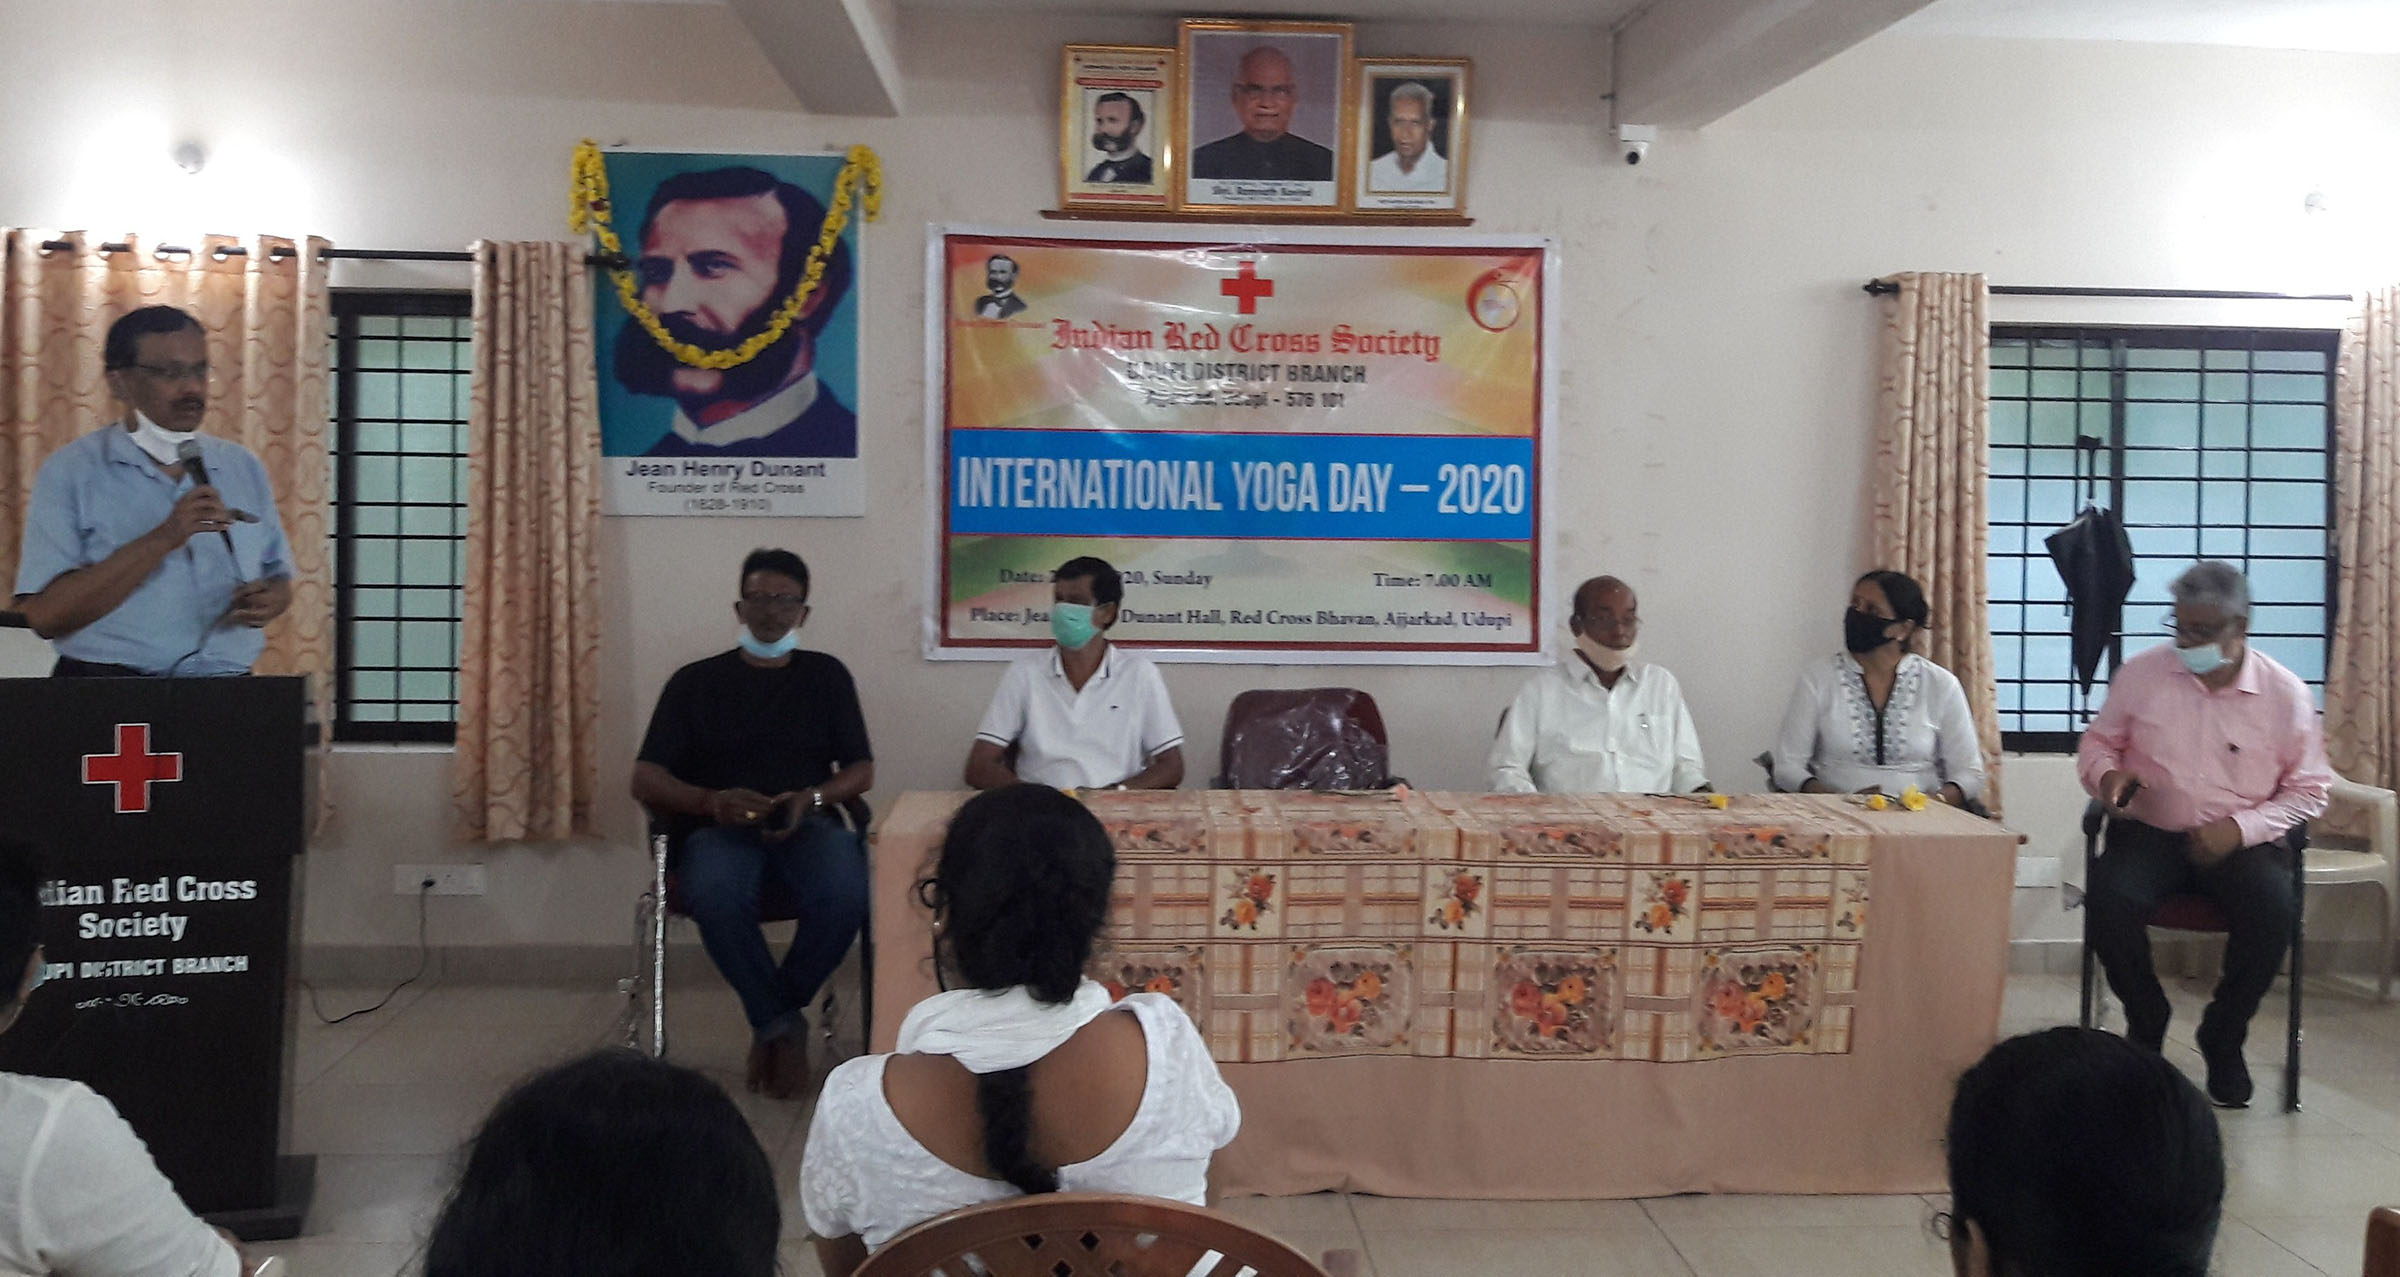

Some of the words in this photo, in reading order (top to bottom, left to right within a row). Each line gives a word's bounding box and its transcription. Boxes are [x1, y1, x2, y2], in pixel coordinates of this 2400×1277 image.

[1051, 319, 1153, 350] Indian
[1164, 322, 1221, 351] Red
[1229, 324, 1320, 354] Cross
[1331, 325, 1442, 362] Society
[1194, 362, 1280, 382] DISTRICT
[1286, 364, 1366, 384] BRANCH
[625, 461, 677, 477] Jean
[682, 461, 745, 481] Henry
[751, 461, 826, 478] Dunant
[648, 481, 706, 494] Founder
[712, 482, 727, 494] of
[730, 482, 760, 494] Red
[764, 482, 805, 495] Cross
[958, 457, 1223, 512] INTERNATIONAL
[1231, 461, 1319, 513] YOGA
[1328, 463, 1393, 513] DAY
[1437, 464, 1526, 515] 2020
[1000, 568, 1044, 584] Date:
[1152, 570, 1213, 589] Sunday
[1373, 572, 1421, 587] Time:
[1424, 573, 1460, 588] 7.00
[1463, 573, 1493, 588] AM
[970, 607, 1019, 623] Place:
[1021, 607, 1051, 626] Jea
[1121, 609, 1183, 624] Dunant
[1186, 609, 1225, 626] Hall,
[1229, 609, 1262, 625] Red
[1265, 610, 1313, 626] Cross
[1461, 612, 1512, 631] Udupi
[40, 879, 105, 906] dian
[111, 876, 170, 904] Red
[176, 875, 258, 901] Cross
[78, 910, 189, 942] Society
[43, 962, 75, 980] UPI
[80, 958, 167, 979] DISTRICT
[172, 955, 249, 975] BRANCH
